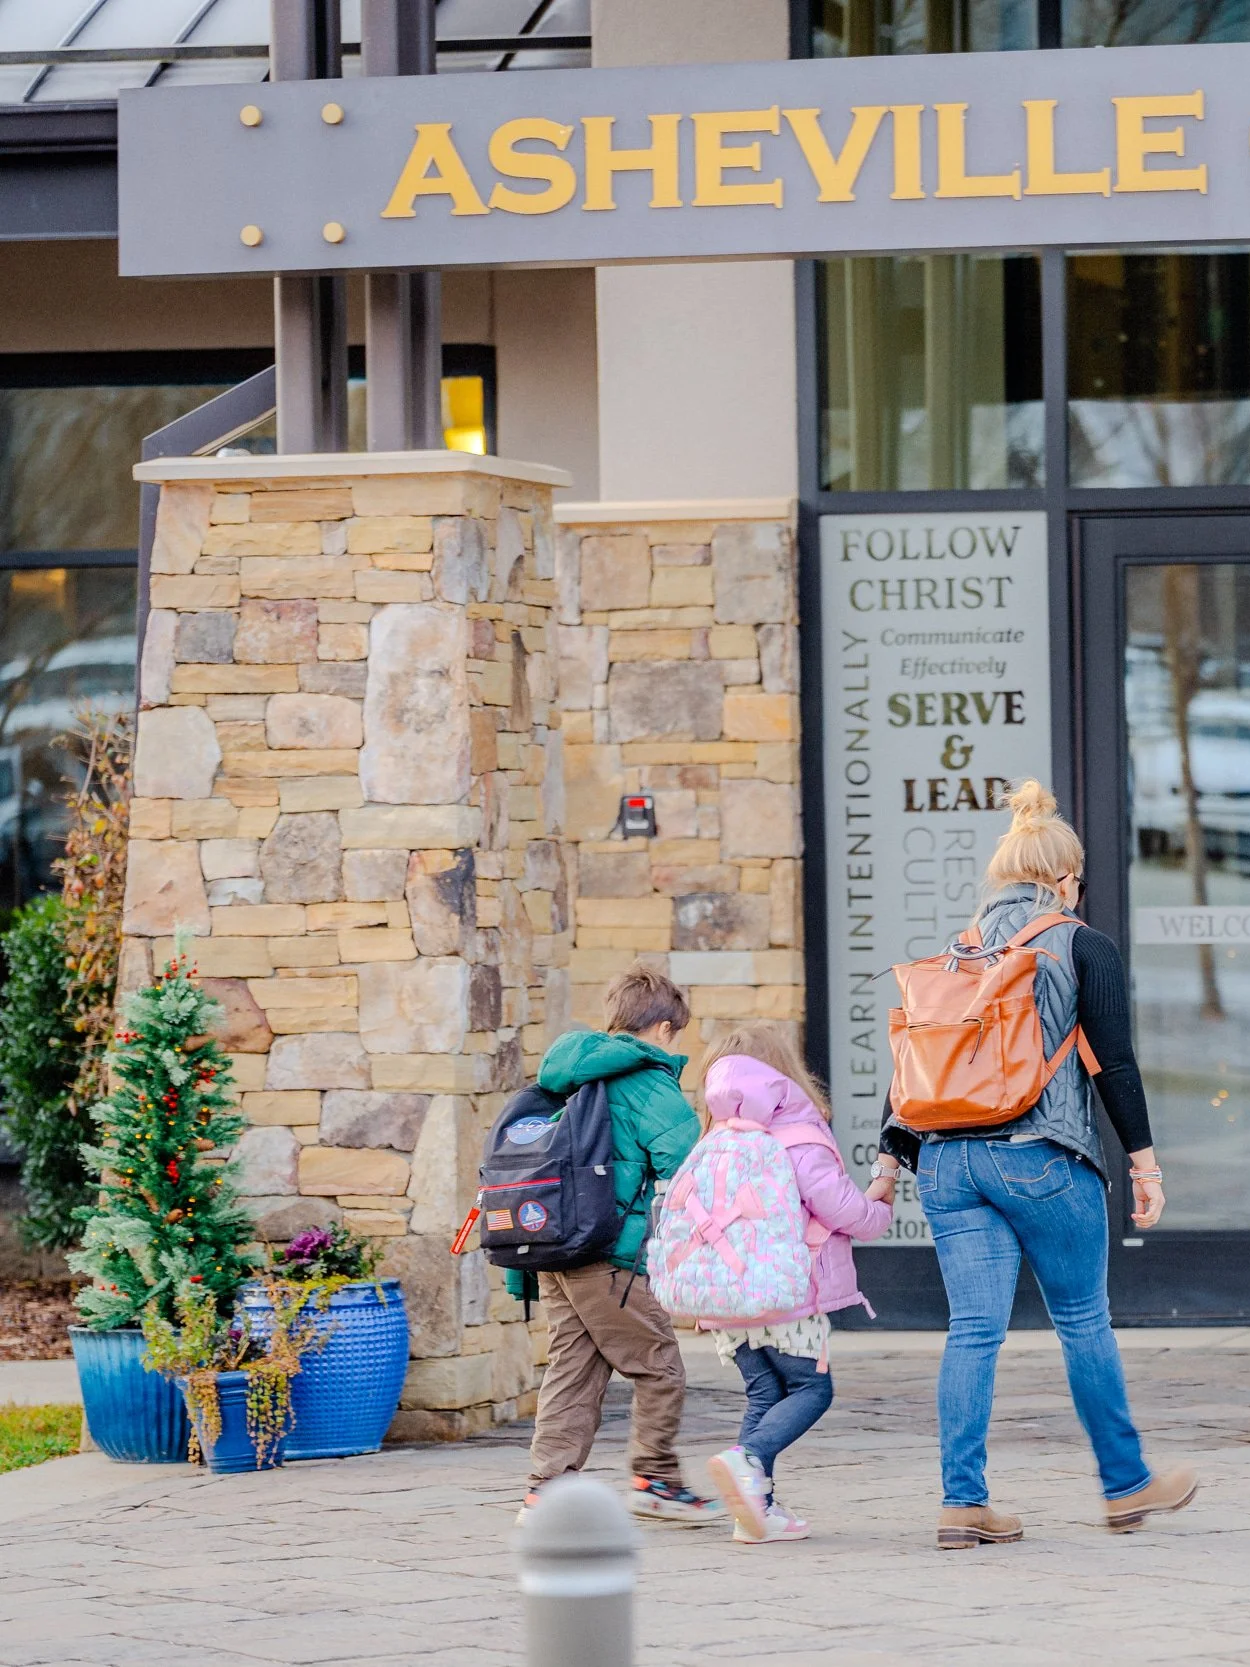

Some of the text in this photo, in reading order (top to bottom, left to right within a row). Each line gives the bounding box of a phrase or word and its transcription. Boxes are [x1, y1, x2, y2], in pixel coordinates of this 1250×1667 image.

[380, 88, 1208, 218] ASHEVILLE
[839, 525, 1023, 563] FOLLOW
[848, 575, 1014, 613] CHRIST
[880, 626, 1025, 647] Communicate
[900, 655, 1007, 680] Effectively
[887, 689, 1027, 729] SERVE
[939, 733, 975, 772] &
[841, 630, 878, 1099] LEARN INTENTIONALLY
